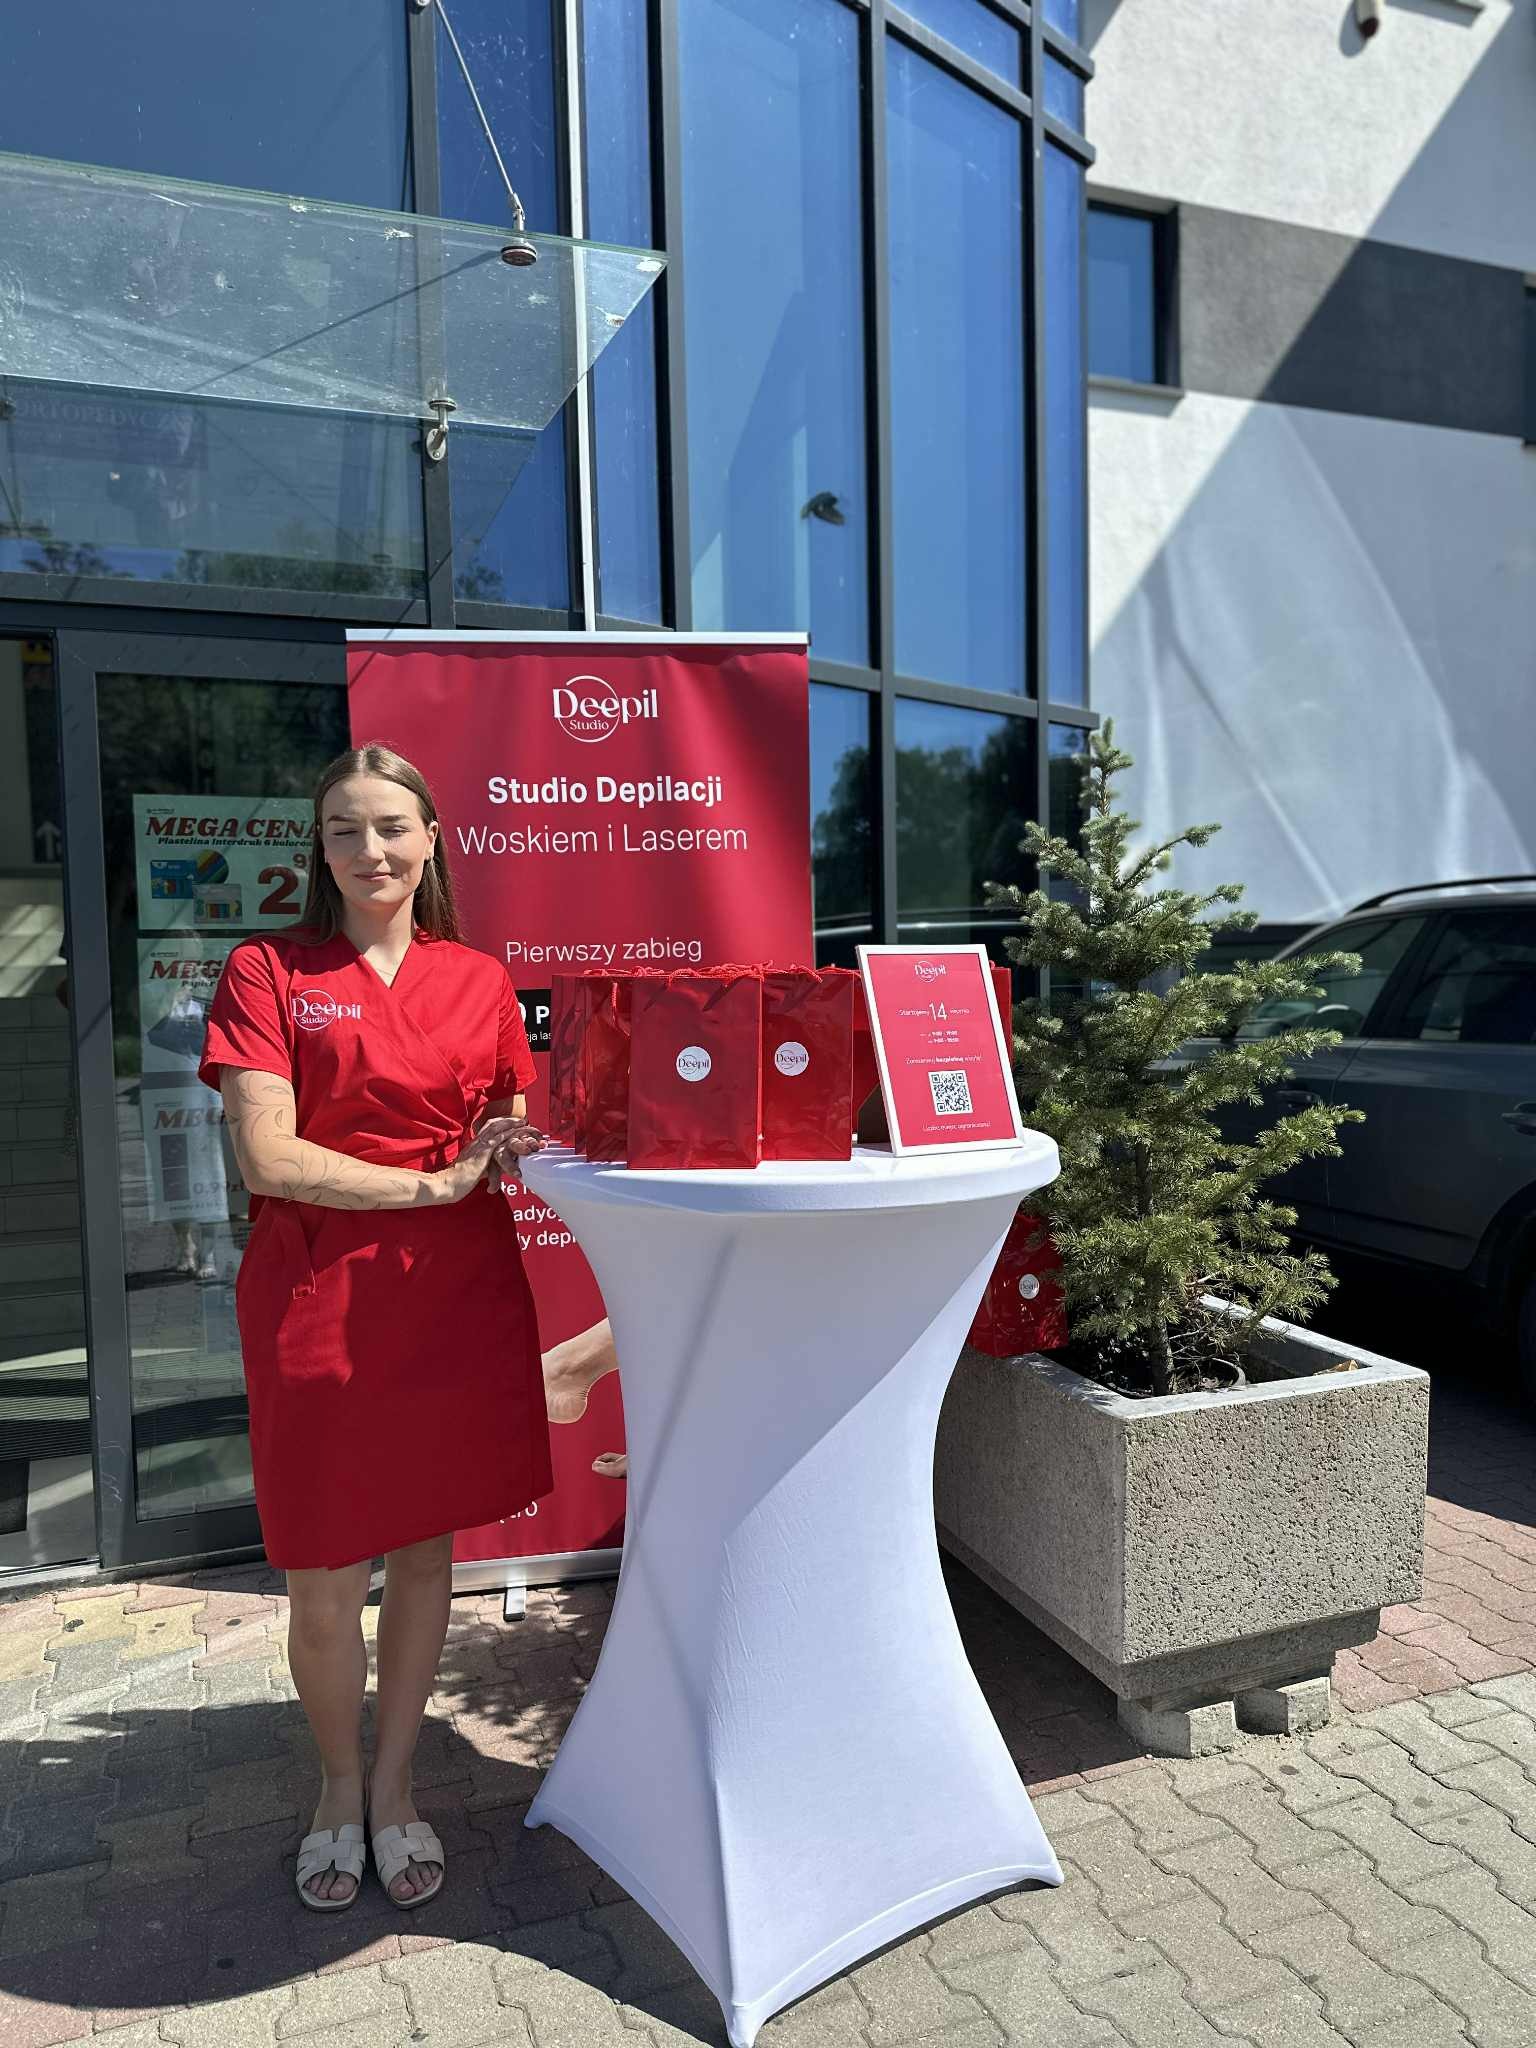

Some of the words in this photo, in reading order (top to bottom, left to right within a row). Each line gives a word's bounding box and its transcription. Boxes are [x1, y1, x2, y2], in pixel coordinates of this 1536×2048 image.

[553, 688, 659, 724] Deepil
[570, 719, 609, 731] Studio
[488, 776, 588, 804] Studio
[596, 775, 723, 808] Depilacji
[145, 816, 239, 838] MEGA
[158, 837, 210, 846] Plastelina
[457, 824, 598, 856] Woskiem
[606, 823, 614, 852] i
[623, 823, 748, 853] Laserem
[258, 865, 301, 915] 2
[506, 941, 616, 965] Pierwszy
[622, 937, 703, 962] zabieg
[291, 998, 361, 1020] Deepil
[300, 1015, 328, 1025] Studio
[929, 1001, 948, 1021] 14
[678, 1058, 710, 1069] Deepil
[776, 1053, 808, 1066] Deepil
